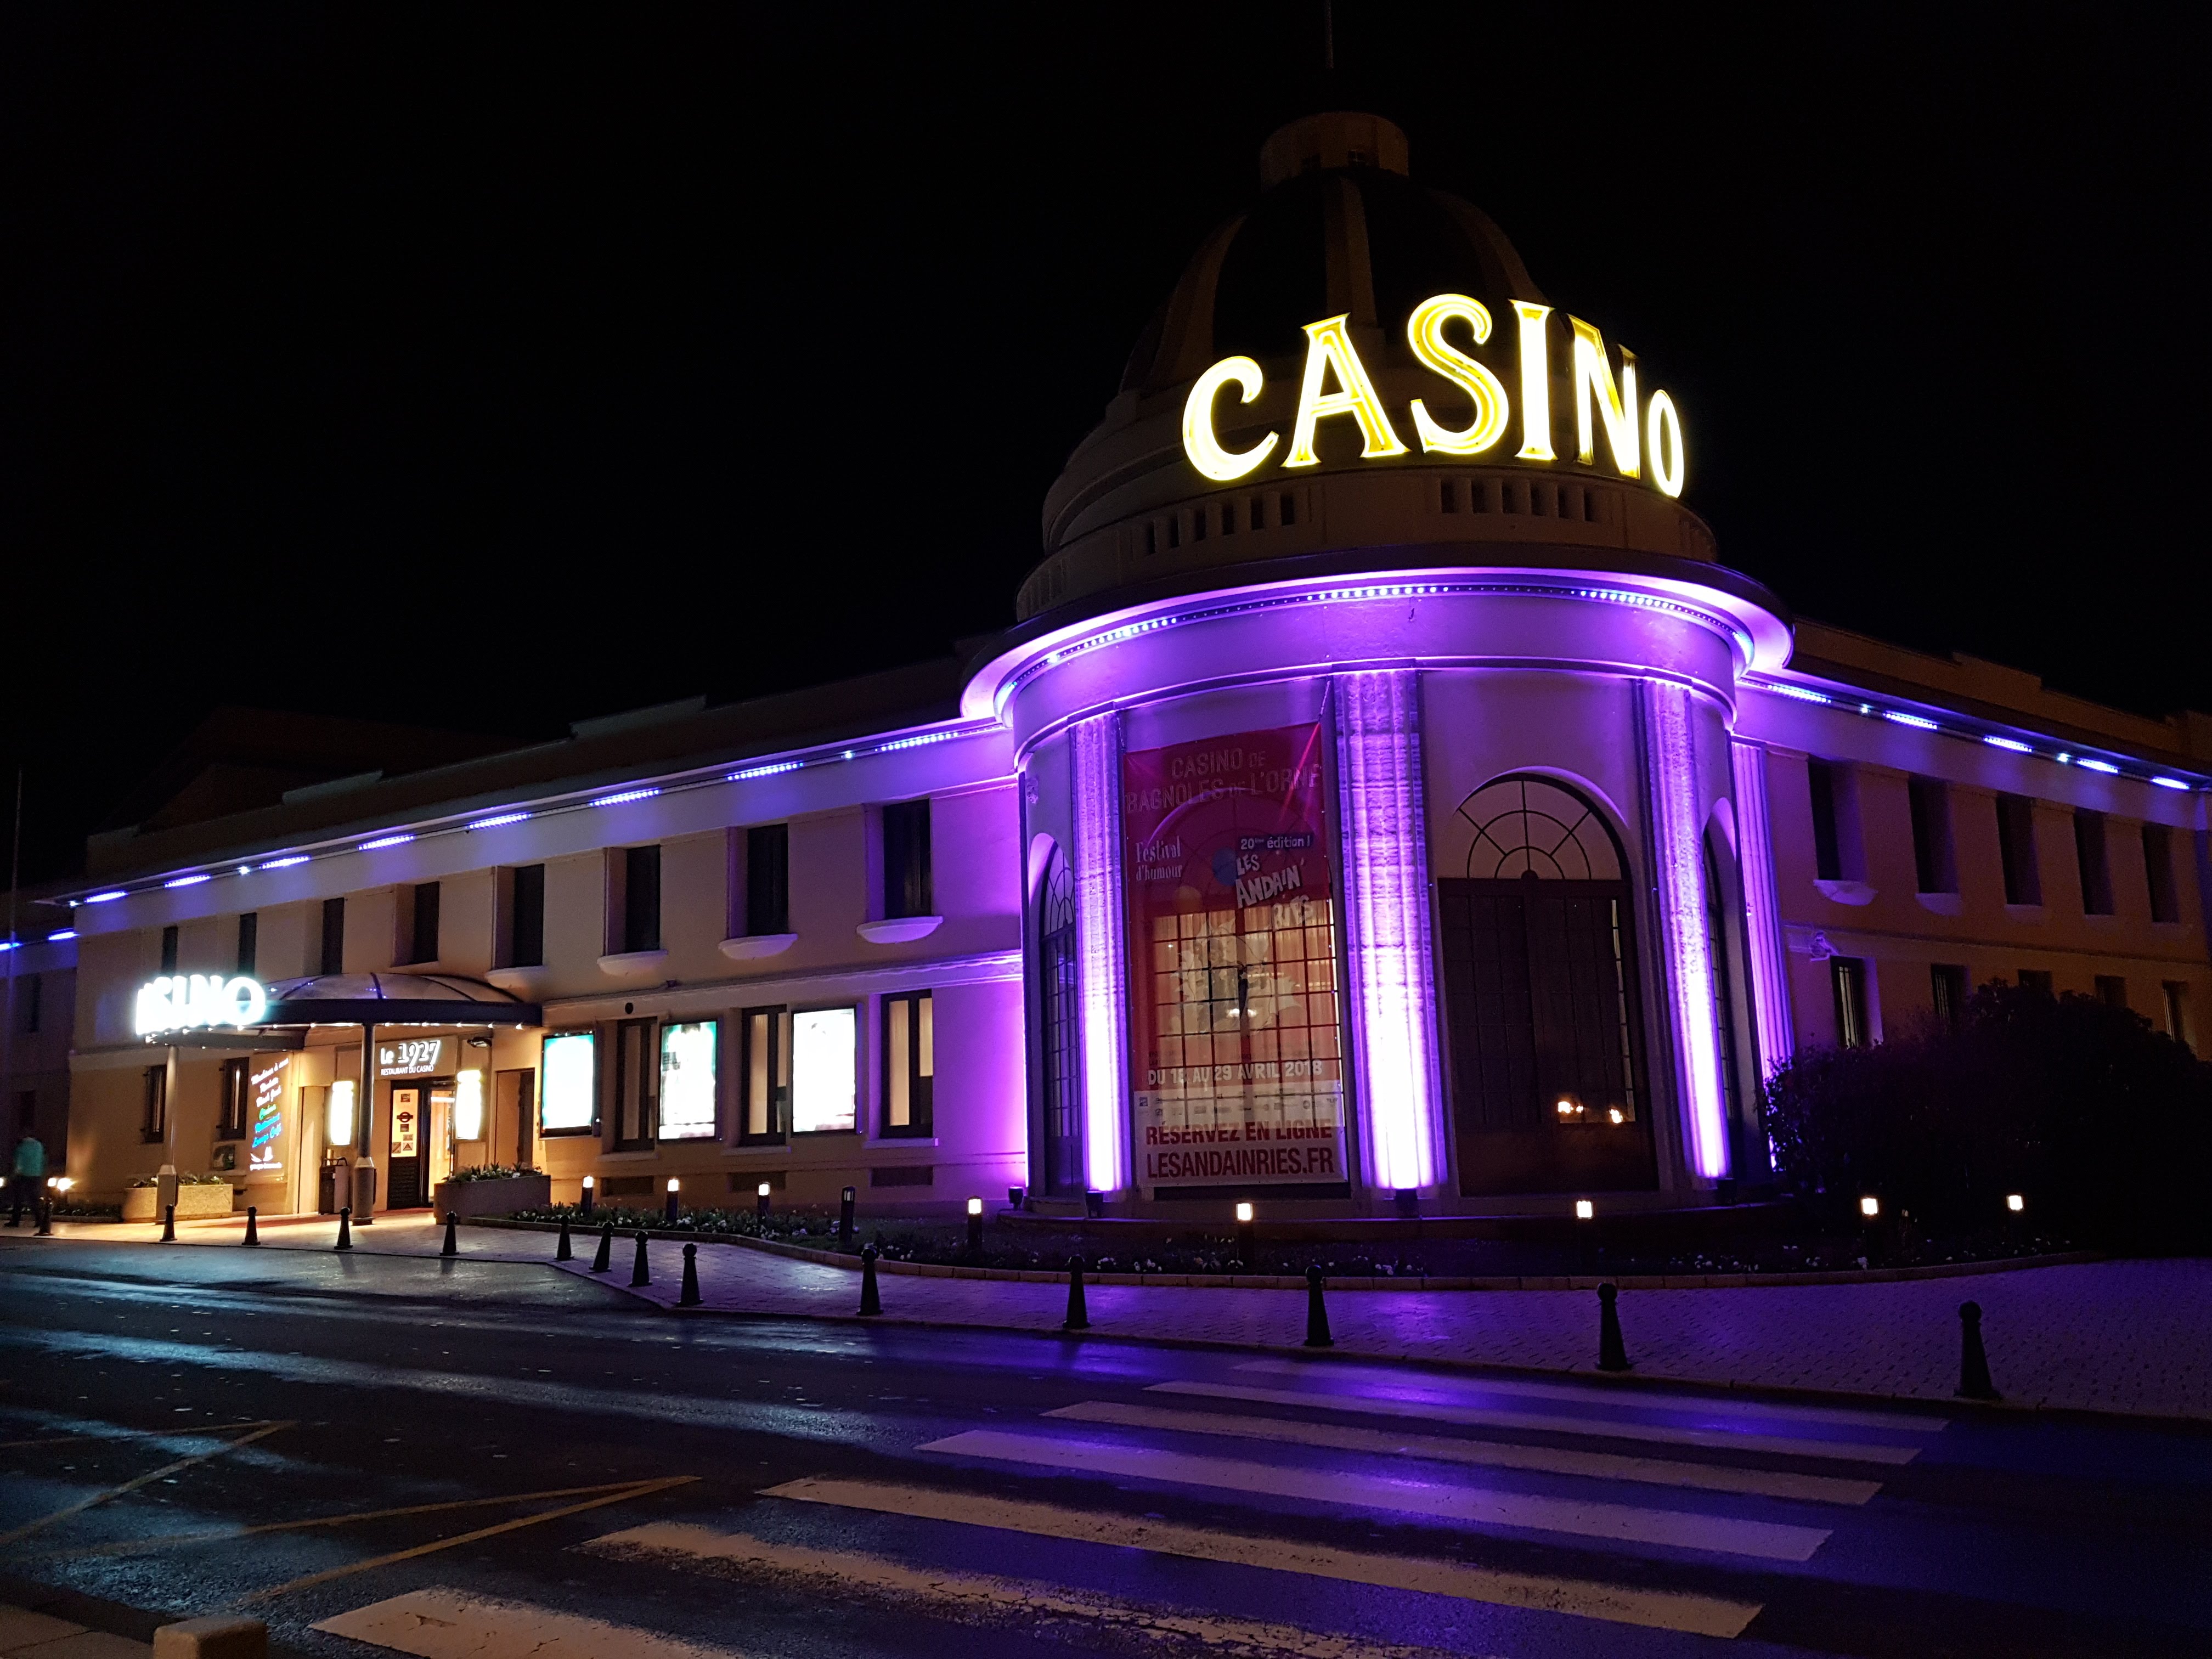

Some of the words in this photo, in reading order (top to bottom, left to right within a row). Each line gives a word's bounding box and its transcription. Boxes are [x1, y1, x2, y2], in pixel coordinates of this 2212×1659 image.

[1182, 293, 1685, 498] CASINO
[1171, 748, 1243, 779] CASINO
[1249, 751, 1266, 768] DE
[1136, 836, 1181, 864] Festival
[1267, 836, 1304, 849] édition
[1136, 864, 1182, 882] d'humour
[1235, 854, 1260, 876] LES
[398, 1040, 441, 1067] 1927
[381, 1066, 409, 1076] RESTAURANT
[416, 1064, 434, 1073] CASINO
[1148, 1069, 1166, 1085] DU
[1193, 1066, 1210, 1083] AU
[1214, 1064, 1232, 1081] 29
[1237, 1062, 1280, 1080] AVRIL
[1285, 1059, 1323, 1077] 2018
[1245, 1121, 1269, 1141] EN
[1276, 1118, 1332, 1140] LIGNE
[1147, 1147, 1334, 1178] LESANDAINRIES.FR
